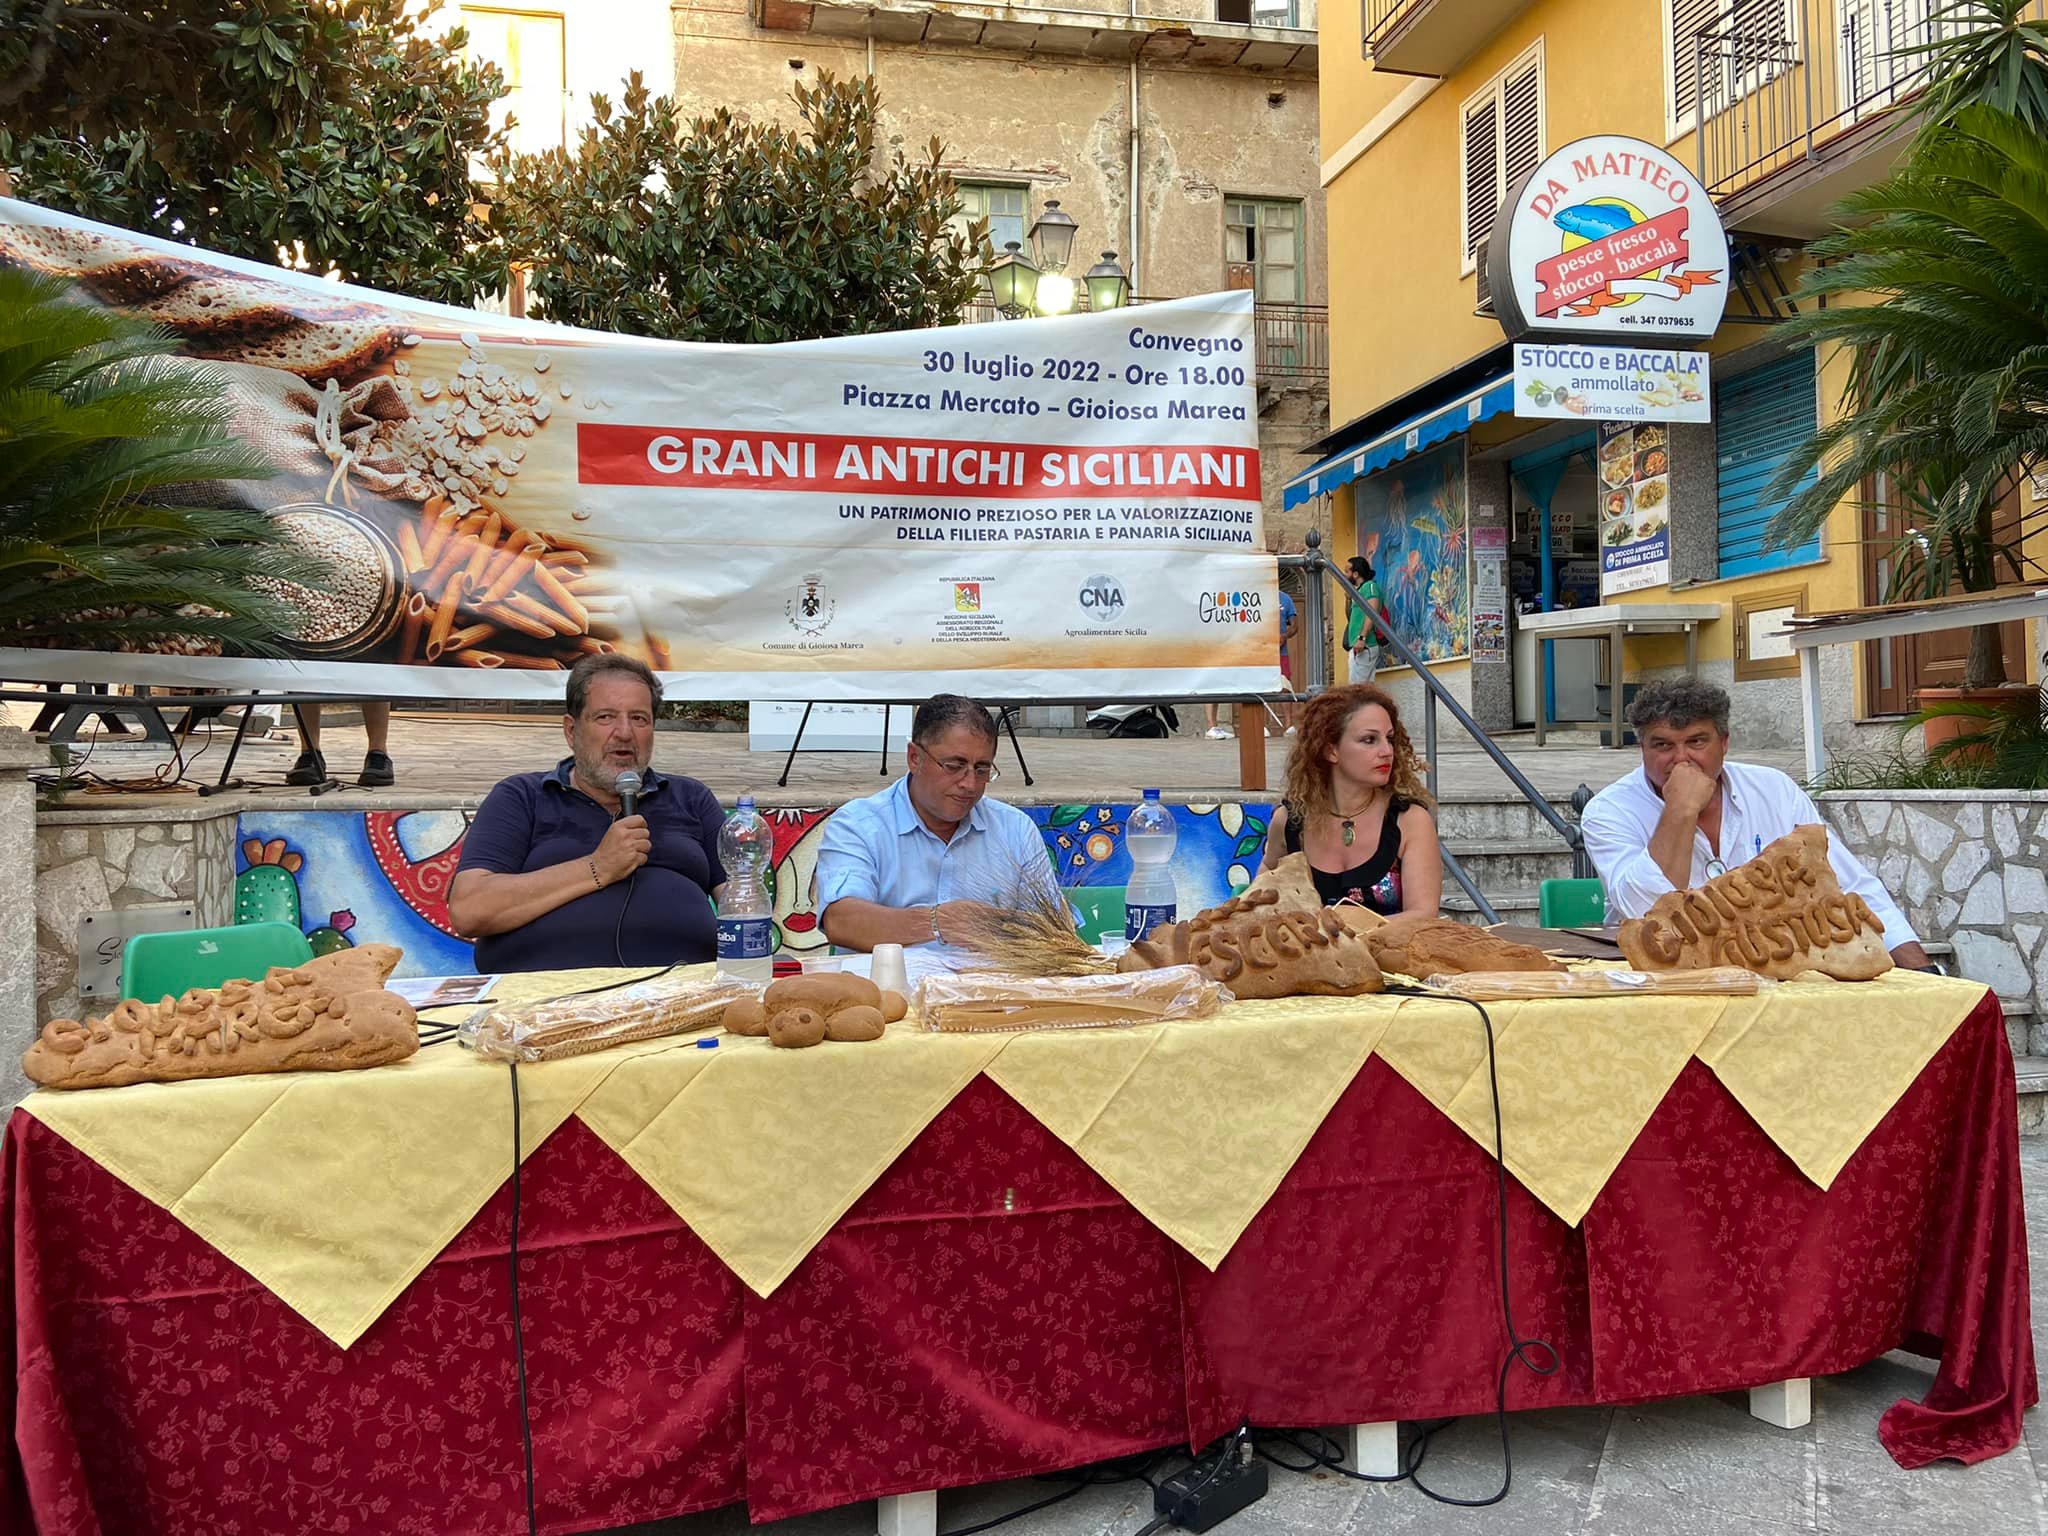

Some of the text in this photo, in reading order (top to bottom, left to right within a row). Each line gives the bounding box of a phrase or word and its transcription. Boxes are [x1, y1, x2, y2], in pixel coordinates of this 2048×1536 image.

[1529, 151, 1690, 221] DA MATTEO
[1556, 226, 1658, 280] pesce fresco
[1552, 269, 1604, 300] stocco
[1616, 237, 1678, 275] baccalà
[1619, 315, 1695, 327] cell. 347 0379635
[1128, 326, 1244, 357] Convegno
[922, 349, 955, 373] 30
[963, 351, 1035, 382] luglio
[1041, 357, 1101, 383] 2022
[1125, 363, 1169, 386] Ore
[1178, 365, 1246, 387] 18.00
[1520, 348, 1704, 374] STOCCO e BACCALA'
[1571, 375, 1655, 393] ammollato
[843, 383, 931, 410] Piazza
[939, 388, 1041, 417] Mercato
[1066, 396, 1159, 421] Gioiosa
[1167, 399, 1247, 421] Marea
[1581, 402, 1646, 416] prima scelta
[646, 434, 1247, 489] GRANI ANTICHI SICILIANI
[838, 504, 1254, 524] UN PATRIMONIO PREZIOSO PER LA VALORIZZAZIONE
[896, 526, 1253, 544] DELLA FILIERA PASTARIA E PANARIA SICILIANA
[1079, 587, 1125, 608] CNA
[1199, 606, 1262, 624] Gustosa
[1064, 627, 1148, 638] Agroalimentare Sicilia
[762, 641, 865, 650] Comune di Gioiosa Marea
